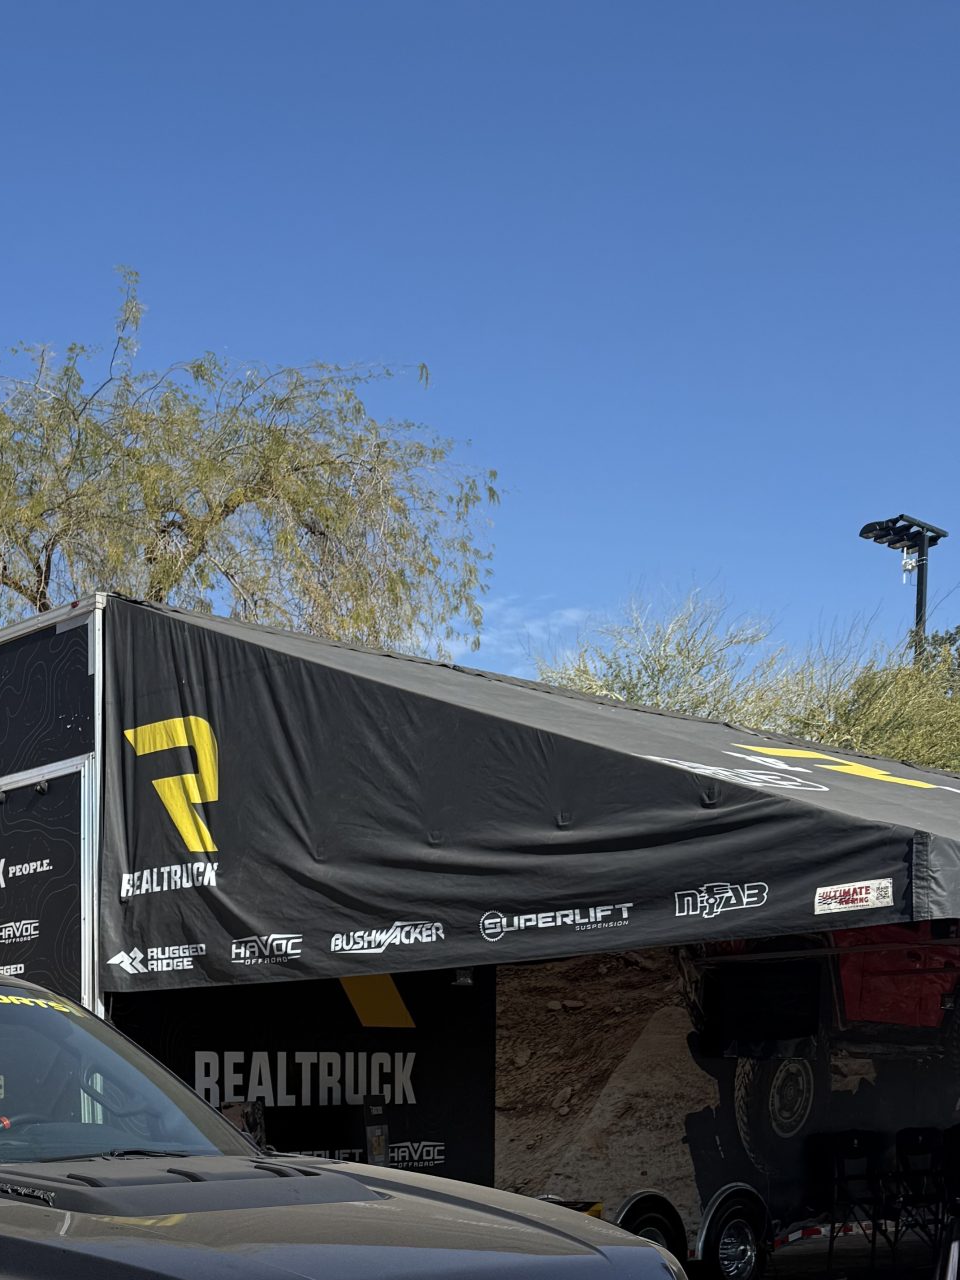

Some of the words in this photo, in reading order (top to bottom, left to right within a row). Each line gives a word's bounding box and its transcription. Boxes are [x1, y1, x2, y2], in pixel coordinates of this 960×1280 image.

[8, 859, 53, 878] PEOPLE.
[121, 862, 218, 898] REALTRUCK
[480, 903, 634, 942] SUPERLIFT
[575, 920, 629, 932] SUSPENSION
[330, 920, 445, 954] BUSHWACKER
[147, 943, 206, 959] RUGGED
[231, 934, 303, 963] HAVOC
[147, 957, 194, 972] RIDGE
[244, 956, 288, 966] OFFROAD
[194, 1050, 417, 1107] REALTRUCK
[388, 1141, 445, 1162] HAVOC
